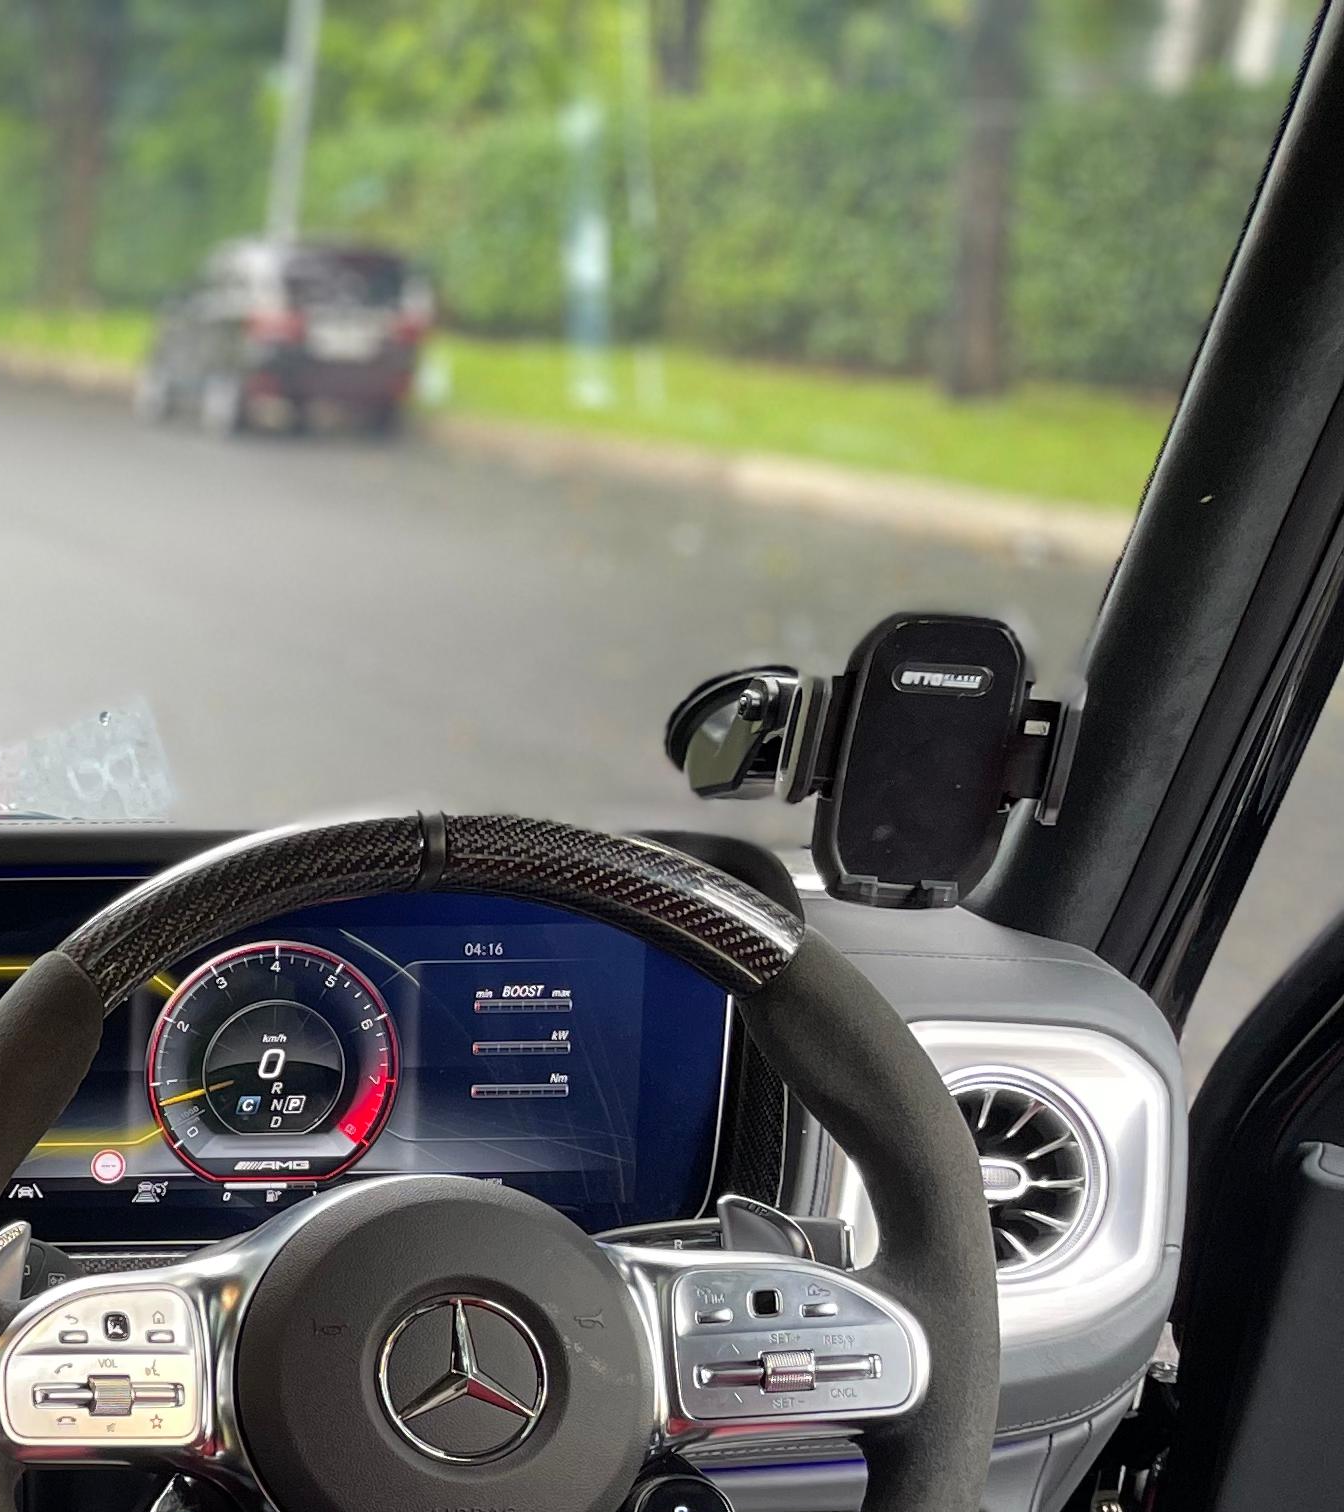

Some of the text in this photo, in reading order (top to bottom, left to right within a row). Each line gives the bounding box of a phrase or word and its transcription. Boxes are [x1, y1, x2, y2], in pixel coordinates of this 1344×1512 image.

[464, 943, 504, 956] 04:16
[270, 961, 281, 973] 4
[215, 976, 228, 990] 3
[324, 974, 338, 988] 5
[475, 985, 572, 998] min BOOST max
[176, 1020, 190, 1033] 2
[361, 1018, 374, 1031] 6
[262, 1033, 287, 1043] km/h
[551, 1030, 570, 1041] kW
[258, 1048, 285, 1079] 0
[166, 1077, 178, 1086] 1
[368, 1075, 381, 1086] 7
[549, 1073, 568, 1084] Nm
[271, 1082, 283, 1094] R
[242, 1100, 254, 1112] C
[270, 1099, 300, 1112] N P
[270, 1116, 282, 1128] D
[186, 1126, 199, 1138] 0
[259, 1160, 310, 1171] AMG
[223, 1192, 232, 1202] 0
[674, 1240, 683, 1250] R
[770, 1333, 791, 1344] SET
[97, 1358, 118, 1369] VOL
[830, 1388, 858, 1399] CNCL
[772, 1397, 794, 1409] SET
